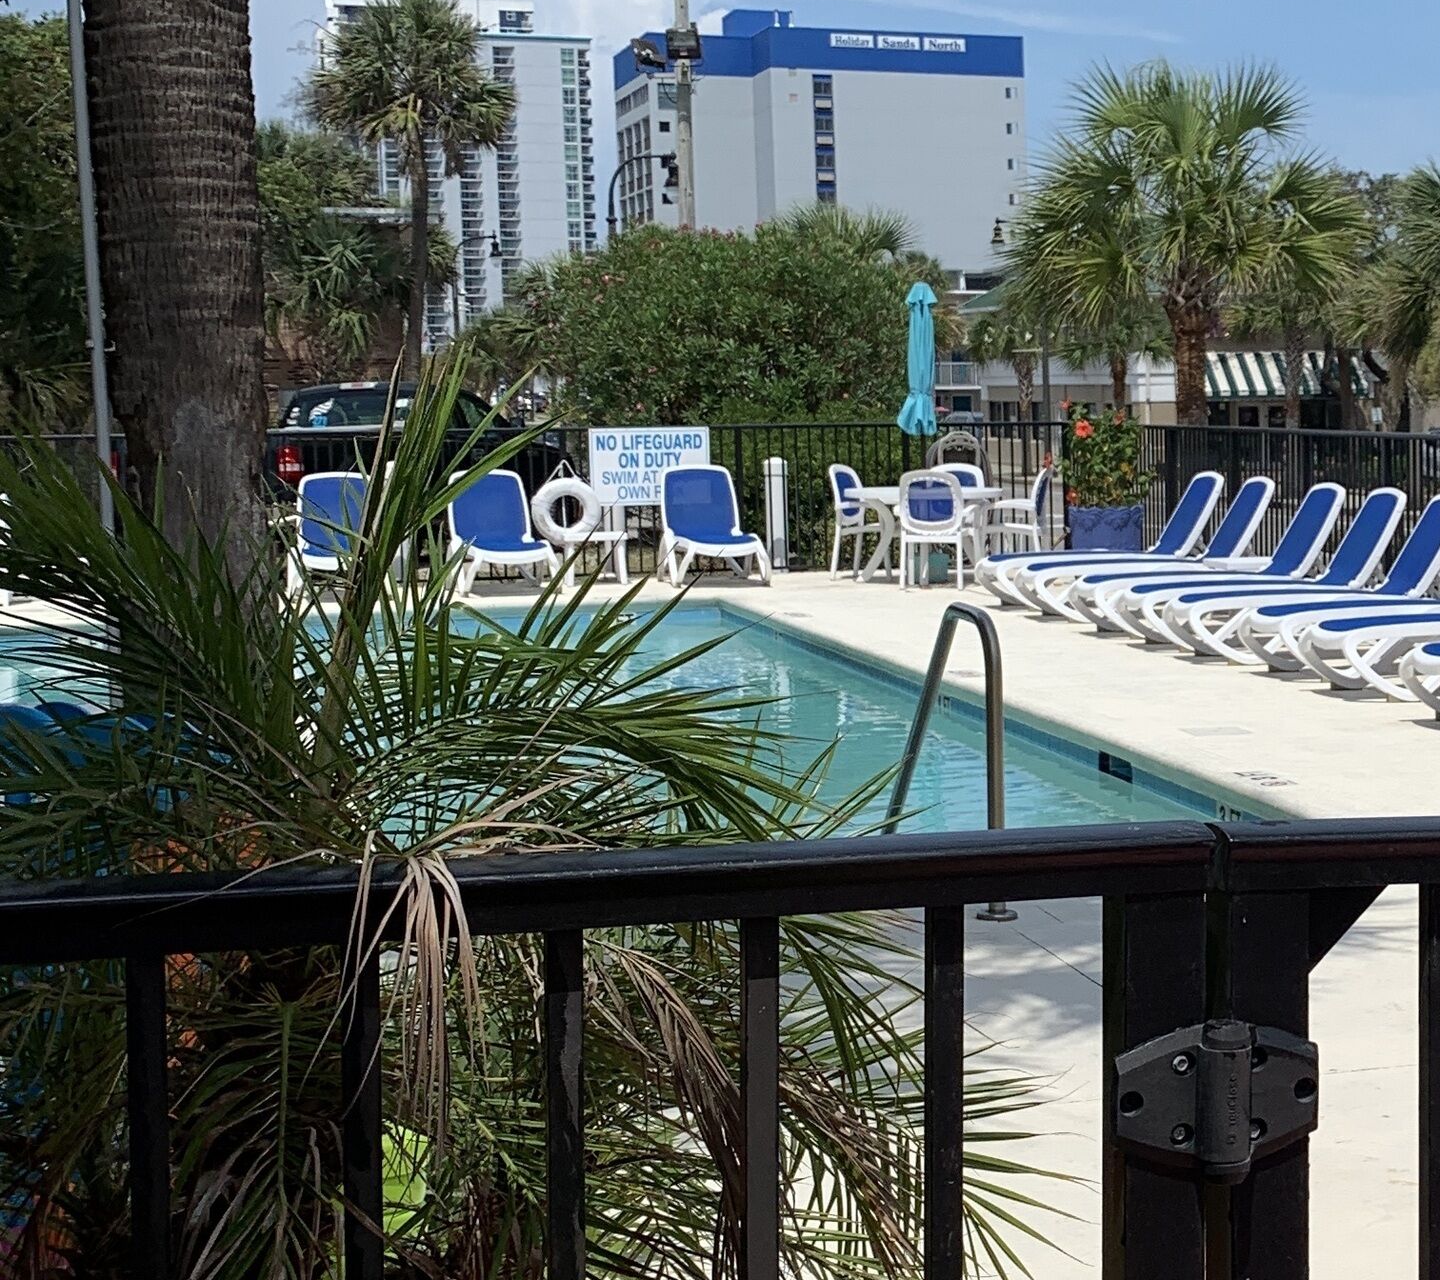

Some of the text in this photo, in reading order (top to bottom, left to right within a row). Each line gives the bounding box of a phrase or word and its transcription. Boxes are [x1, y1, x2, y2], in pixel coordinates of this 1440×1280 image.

[834, 35, 961, 51] Holiday Sands North
[596, 434, 702, 451] NO LIFEGUARD
[618, 451, 681, 468] ON DUTY
[602, 470, 658, 485] SWIM AT
[617, 485, 650, 499] OWN
